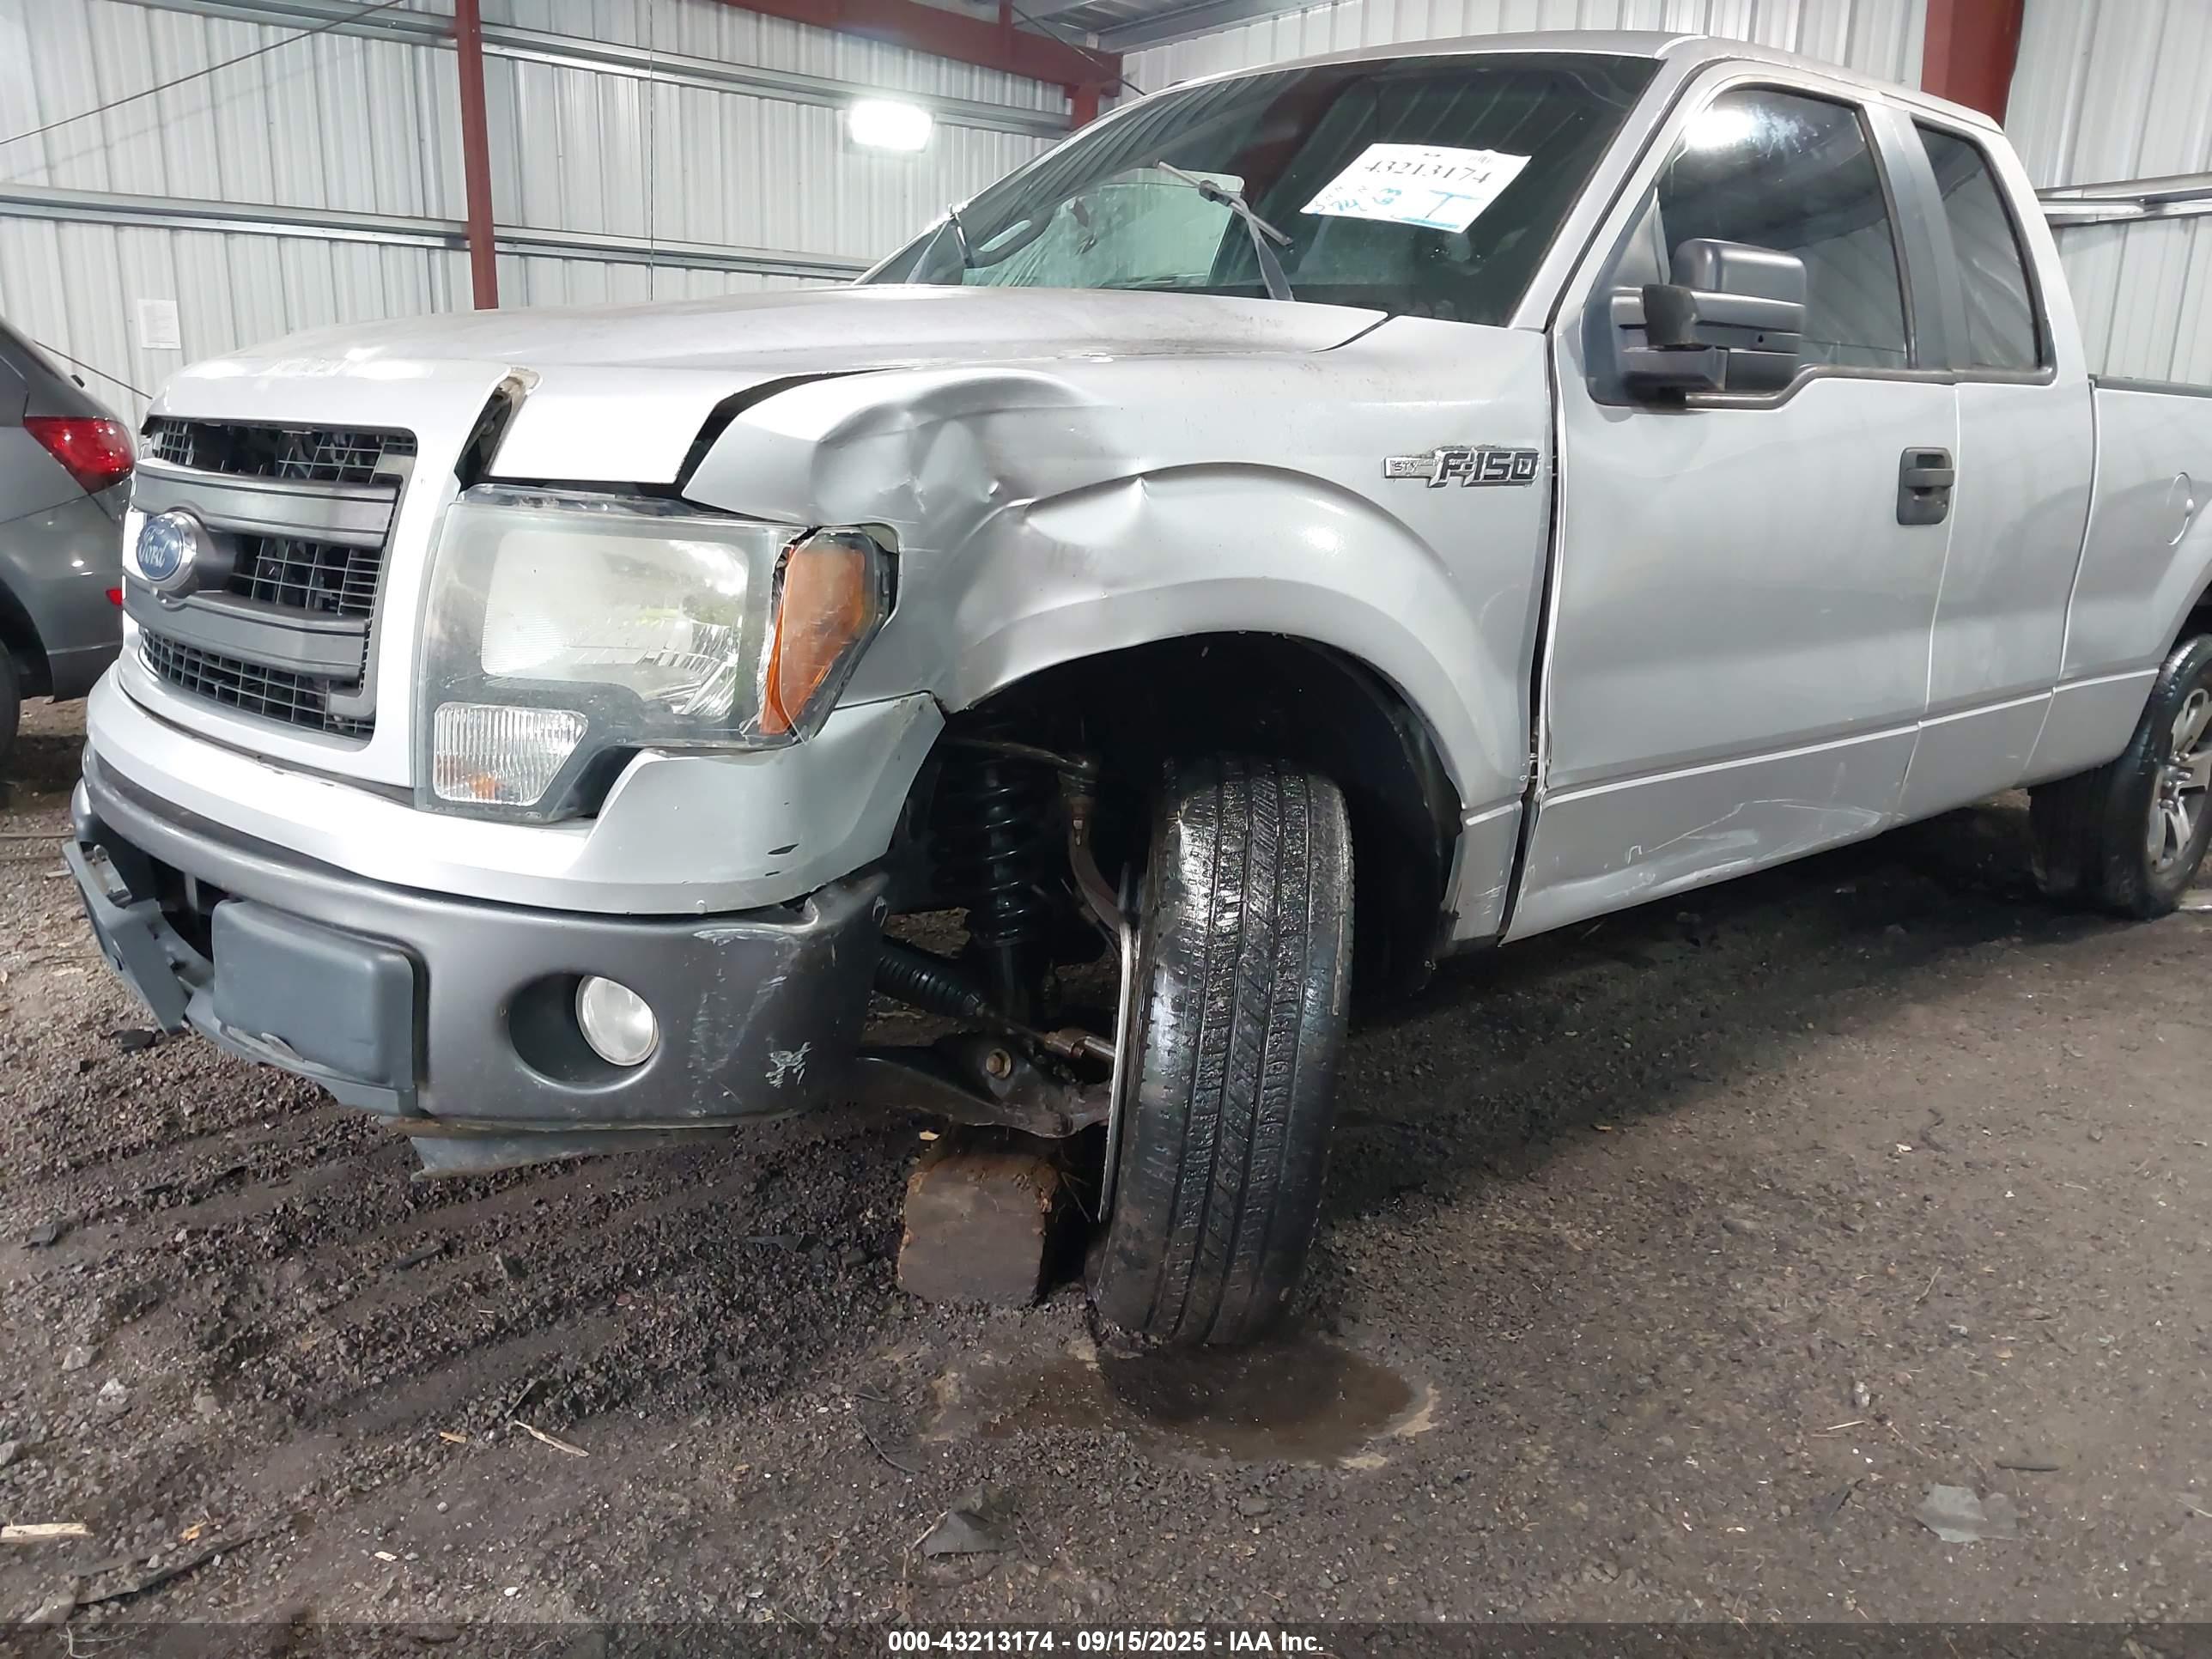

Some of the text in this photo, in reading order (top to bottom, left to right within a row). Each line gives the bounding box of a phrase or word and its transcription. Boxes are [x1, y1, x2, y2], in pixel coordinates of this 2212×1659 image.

[1364, 160, 1492, 184] 43213174
[1432, 449, 1540, 485] F-150
[138, 524, 171, 568] Ford
